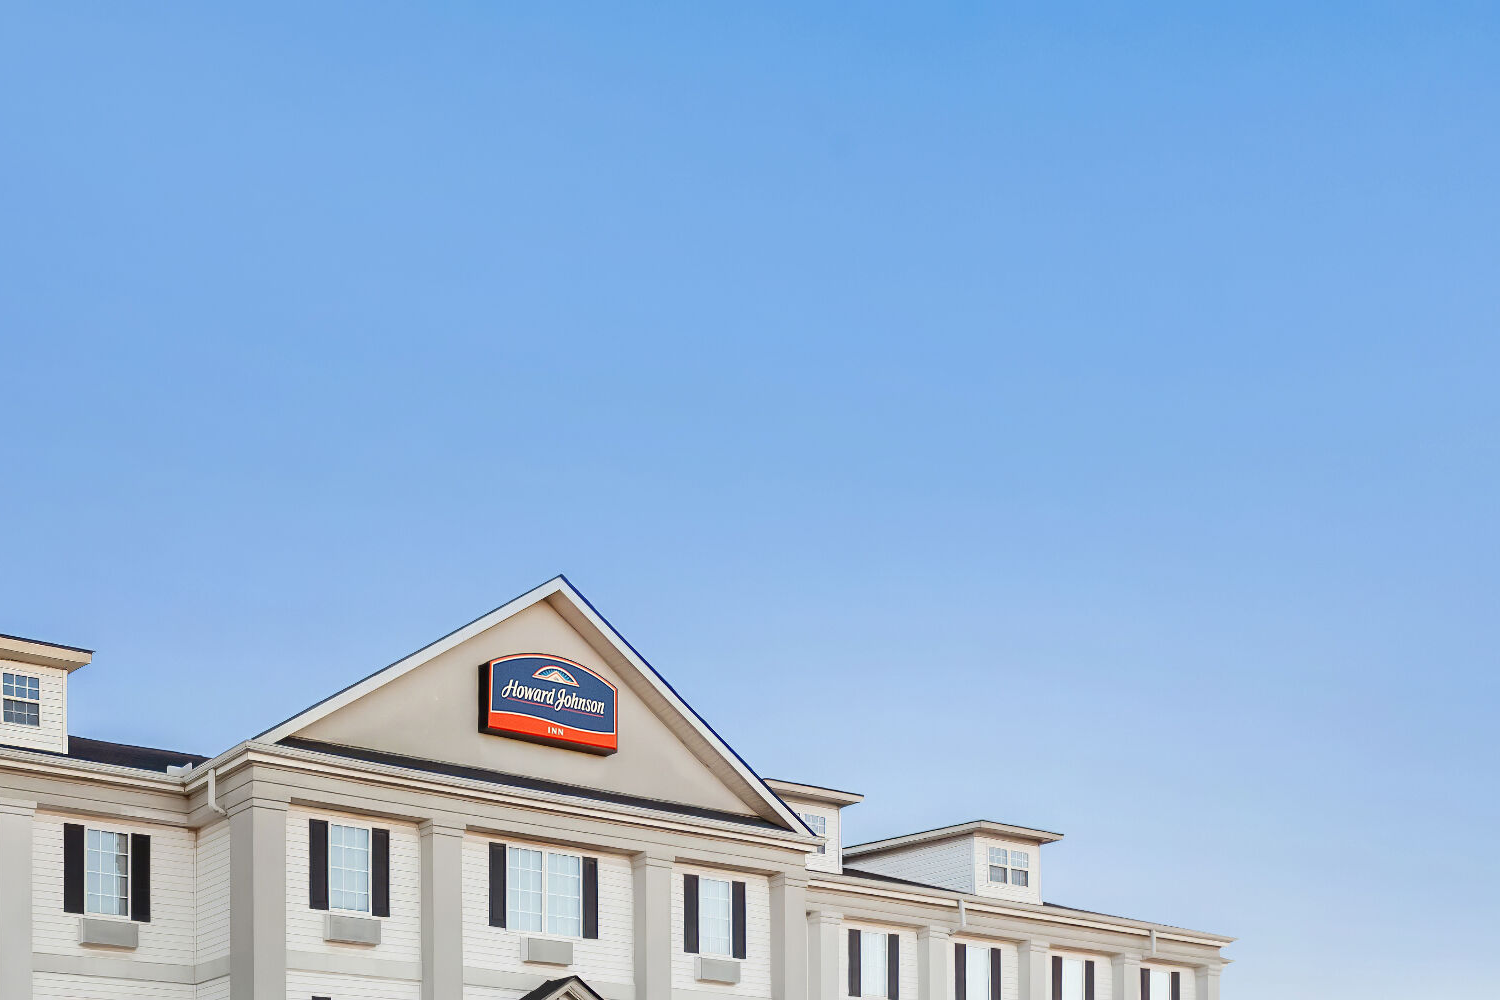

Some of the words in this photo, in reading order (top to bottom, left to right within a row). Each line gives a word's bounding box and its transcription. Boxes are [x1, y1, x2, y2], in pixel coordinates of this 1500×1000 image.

[501, 679, 556, 705] Howard
[554, 688, 605, 715] Johnson
[547, 726, 564, 736] INN
